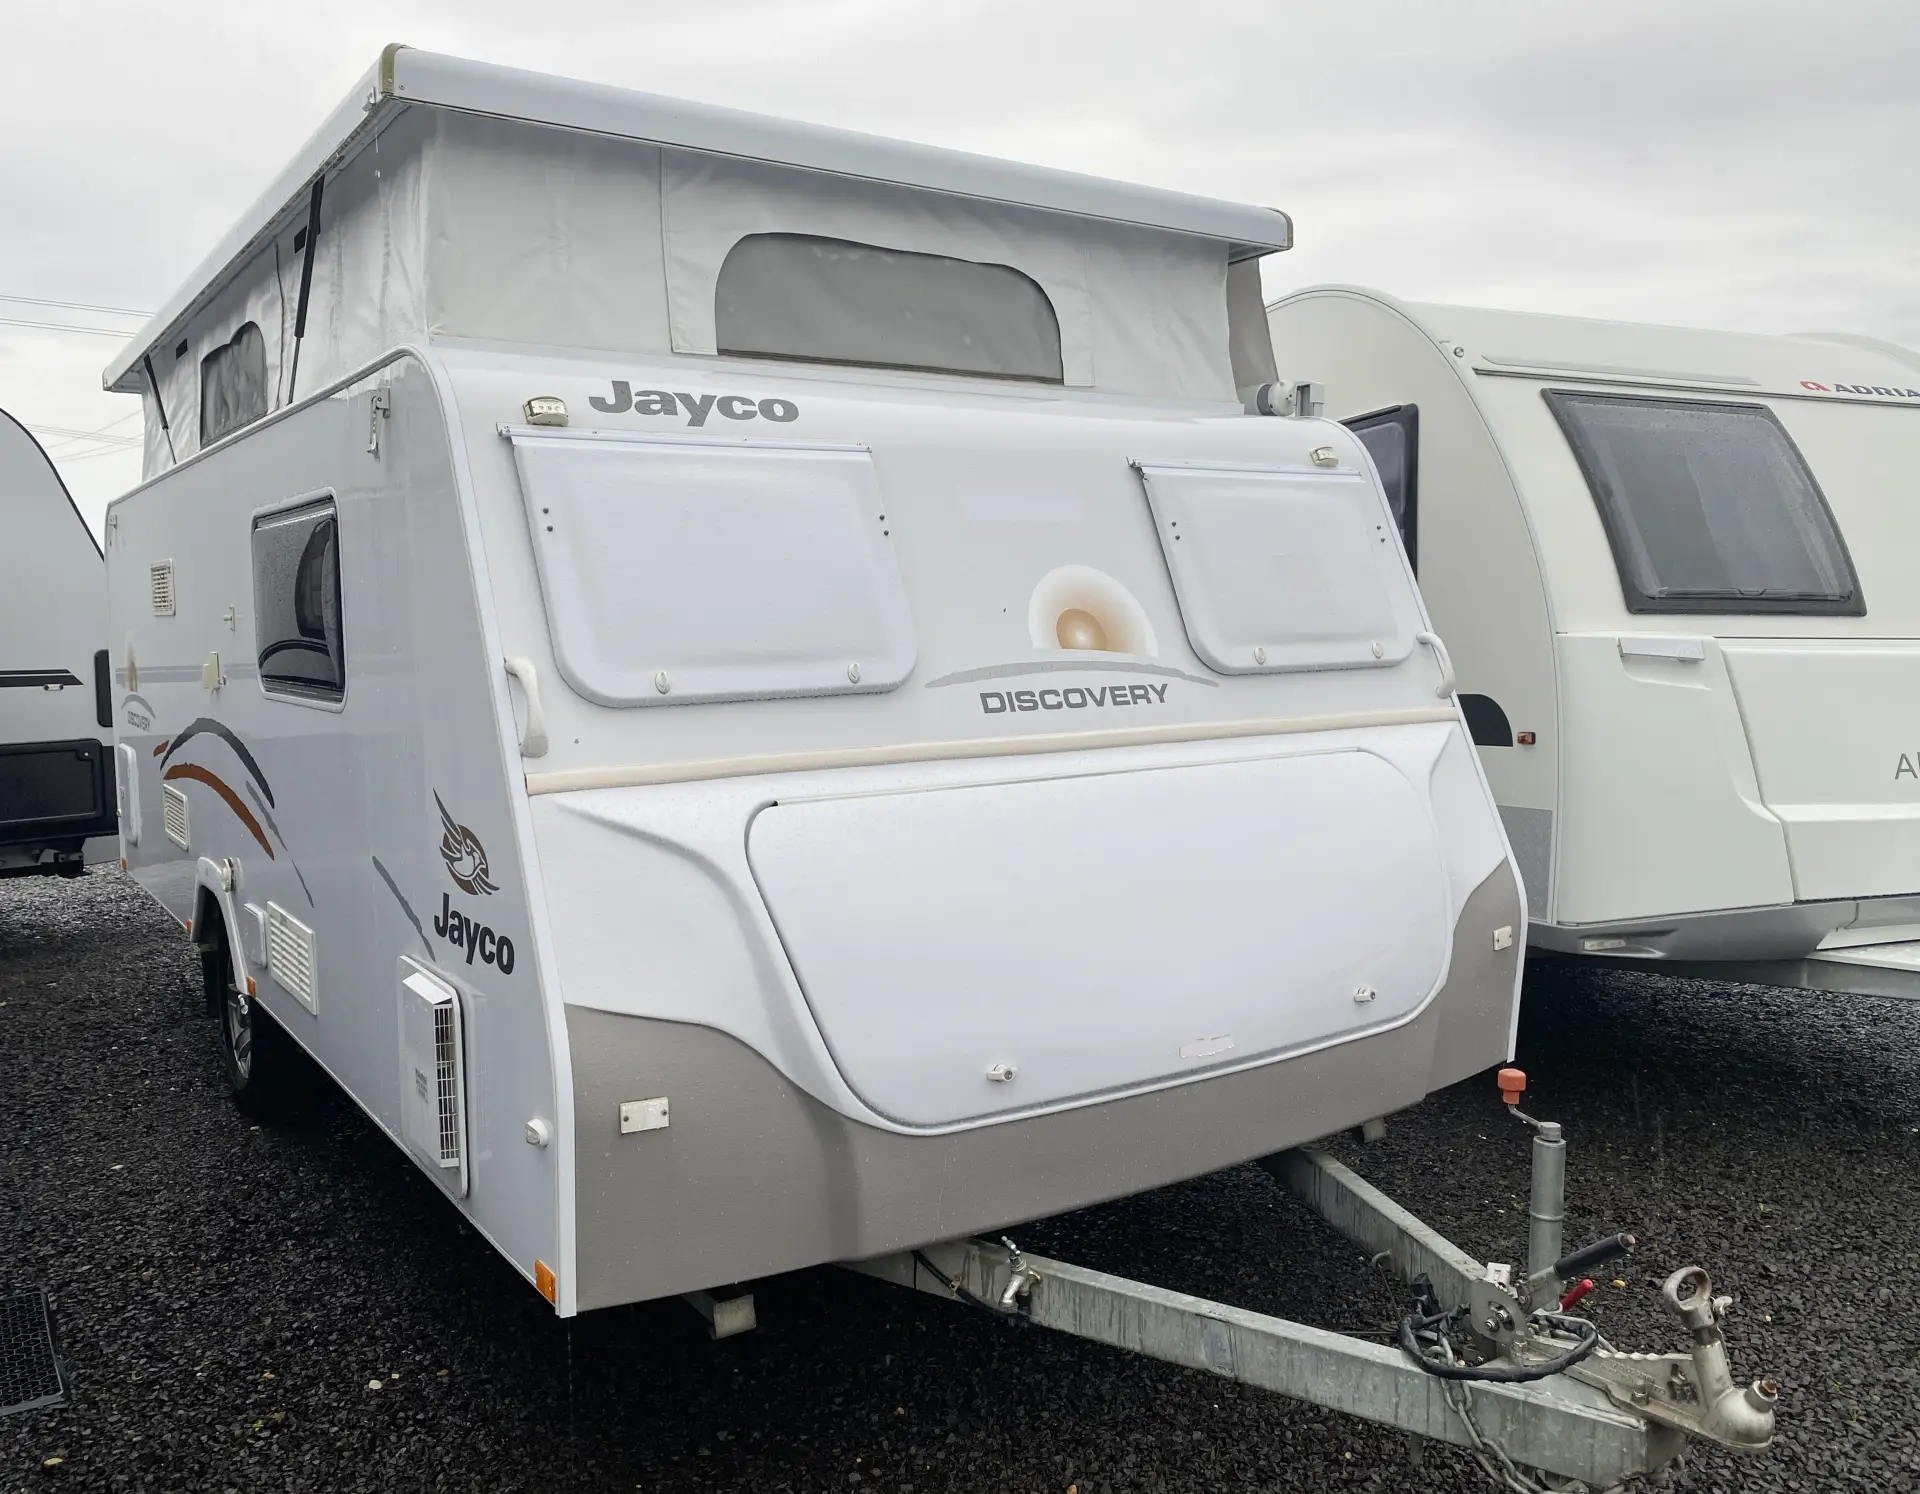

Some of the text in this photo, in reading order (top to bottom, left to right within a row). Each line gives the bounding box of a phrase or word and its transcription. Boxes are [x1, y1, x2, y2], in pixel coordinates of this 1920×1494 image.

[588, 380, 800, 427] Jayco
[980, 684, 1168, 714] DISCOVERY
[434, 891, 515, 975] Jayco
